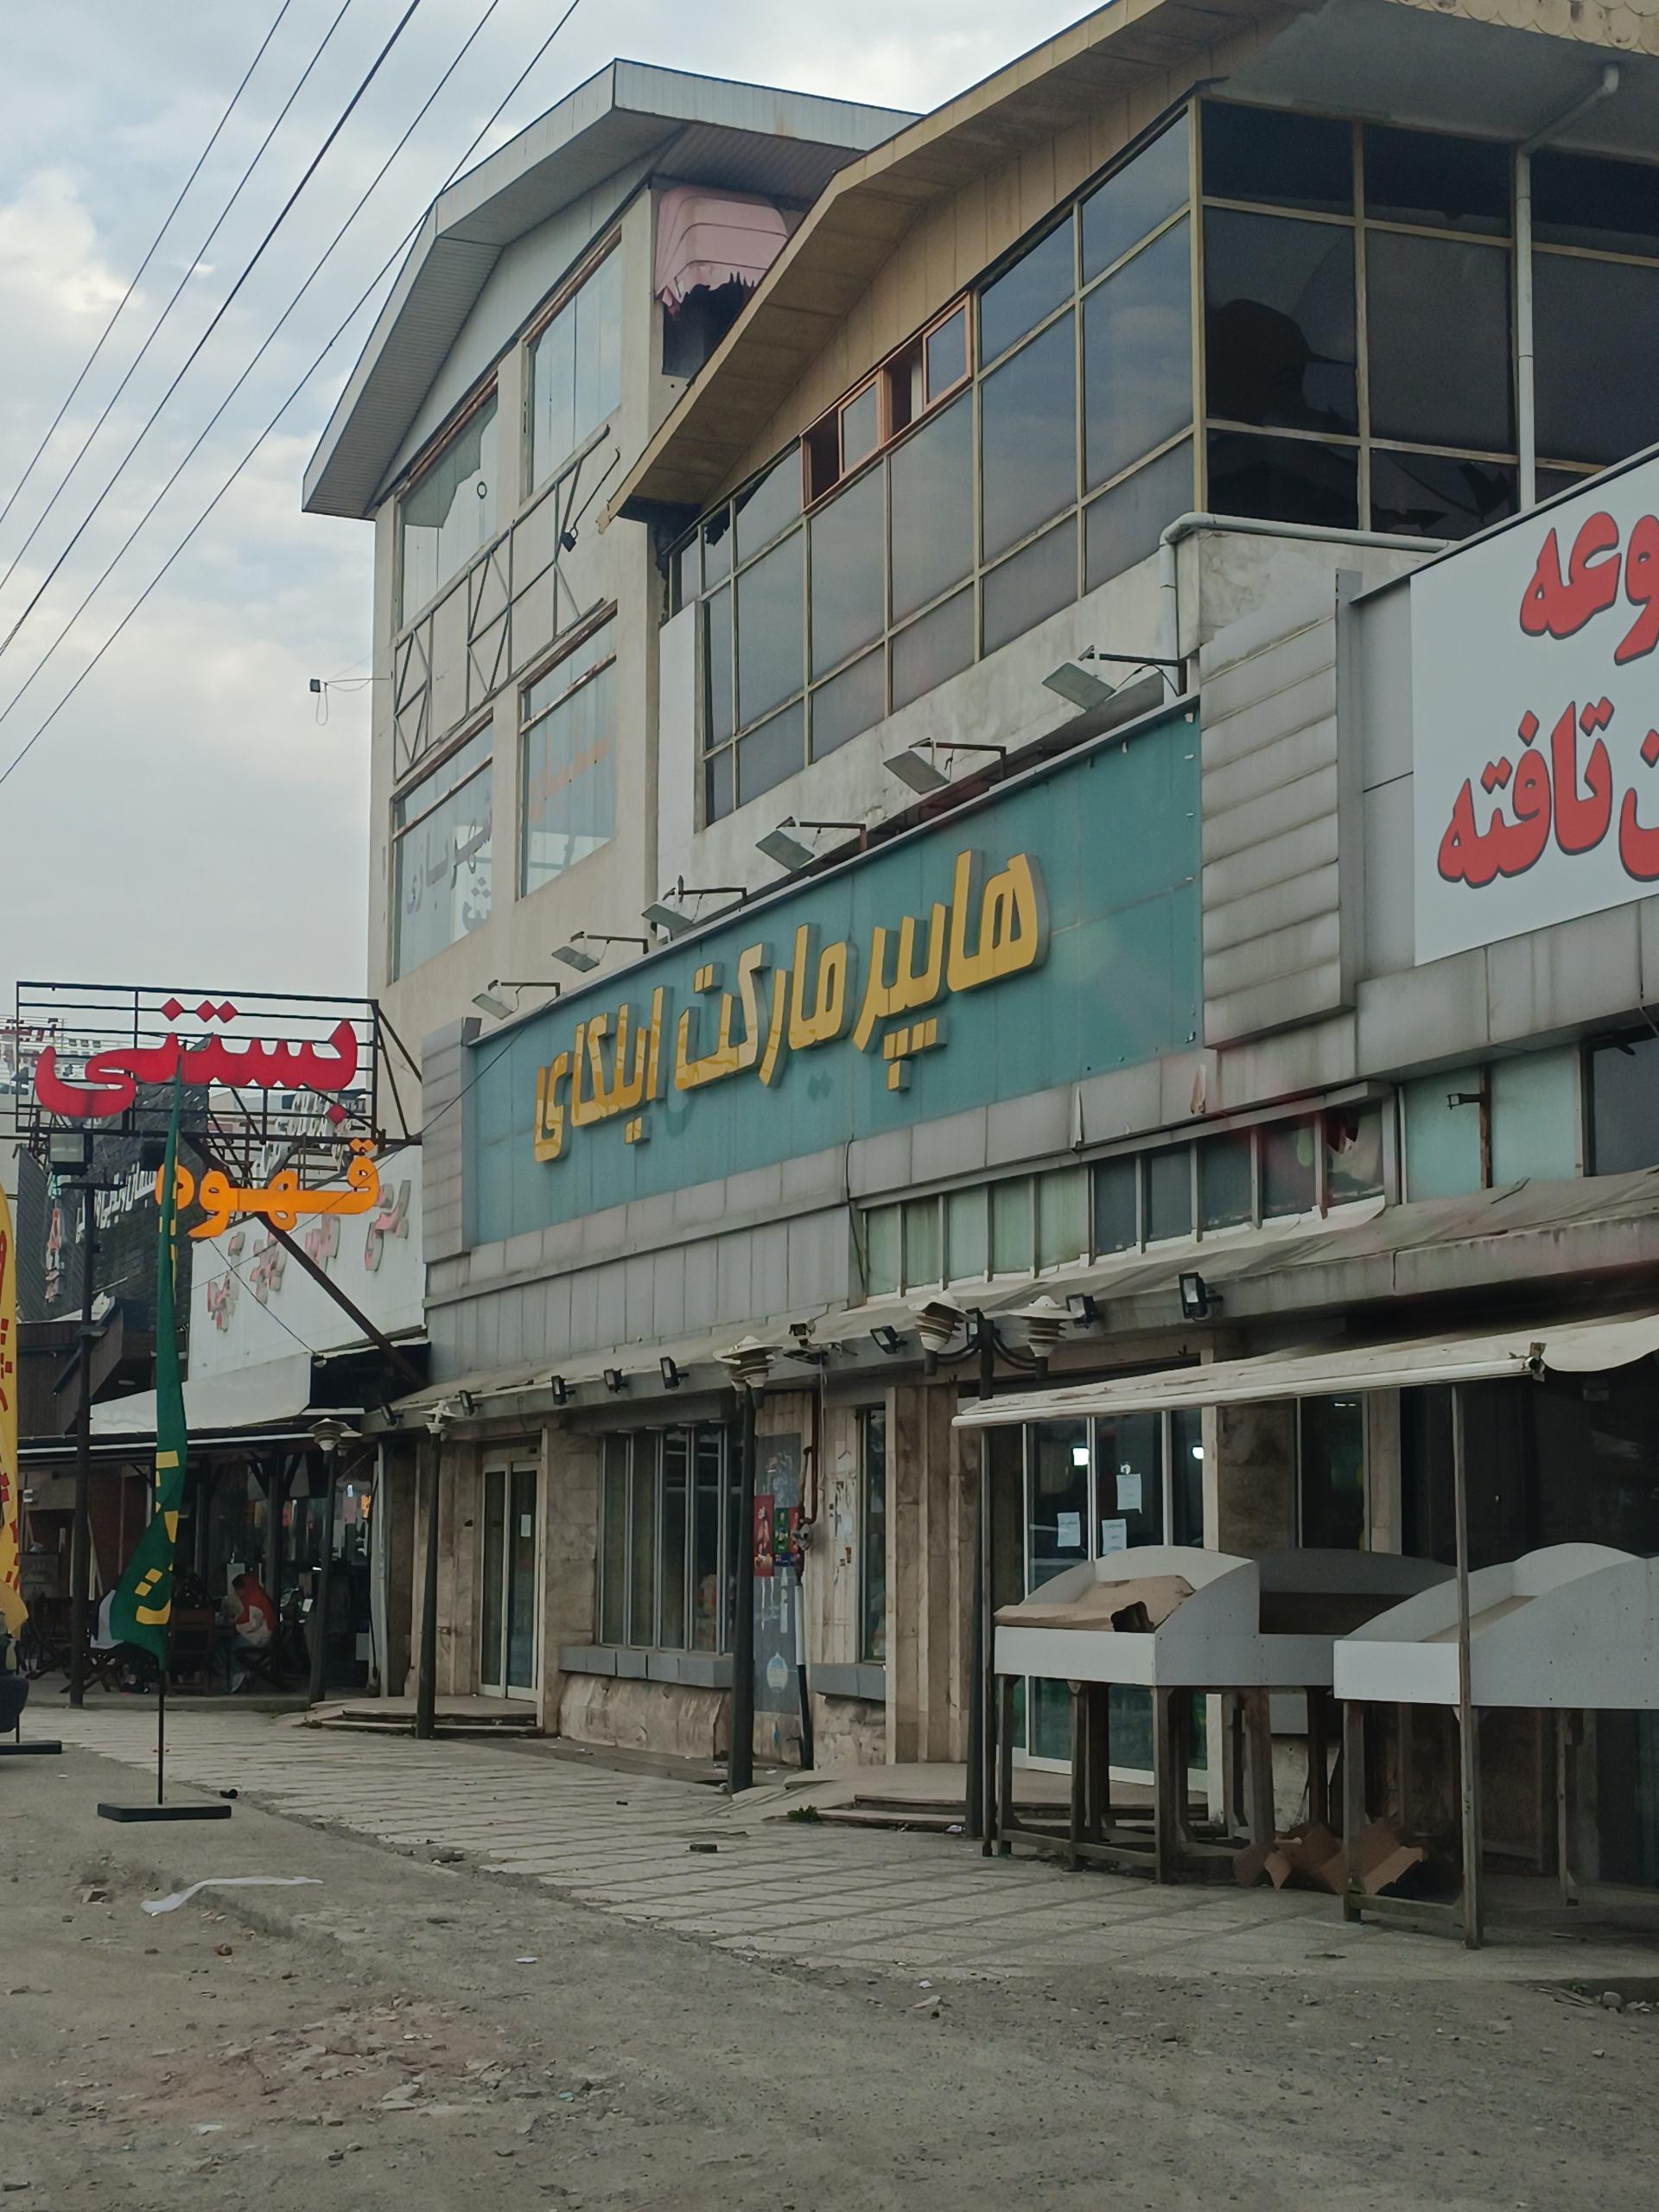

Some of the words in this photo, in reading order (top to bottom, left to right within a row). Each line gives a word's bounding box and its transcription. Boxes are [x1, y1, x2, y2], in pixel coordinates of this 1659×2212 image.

[1519, 511, 1659, 666] وعه
[1437, 696, 1614, 889] تافته
[34, 997, 358, 1124] بستنی
[155, 1137, 381, 1238] قهوه
